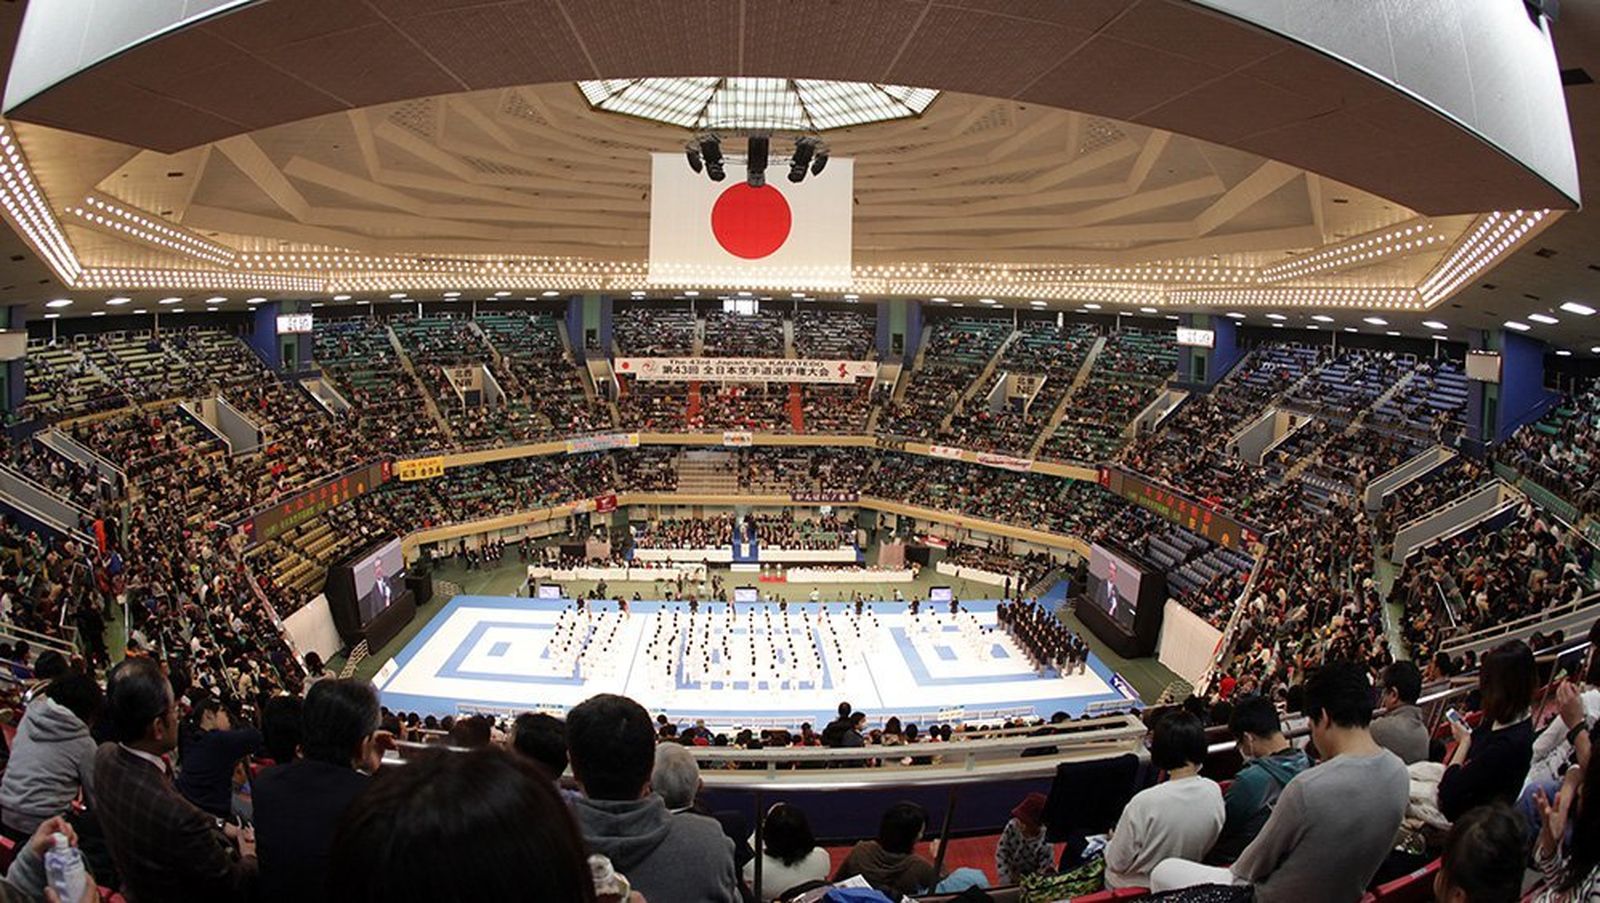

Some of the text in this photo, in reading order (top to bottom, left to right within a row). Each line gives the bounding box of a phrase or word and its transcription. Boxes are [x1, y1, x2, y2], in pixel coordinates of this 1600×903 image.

[662, 365, 829, 377] 第43回 全日本空手道選手権大会
